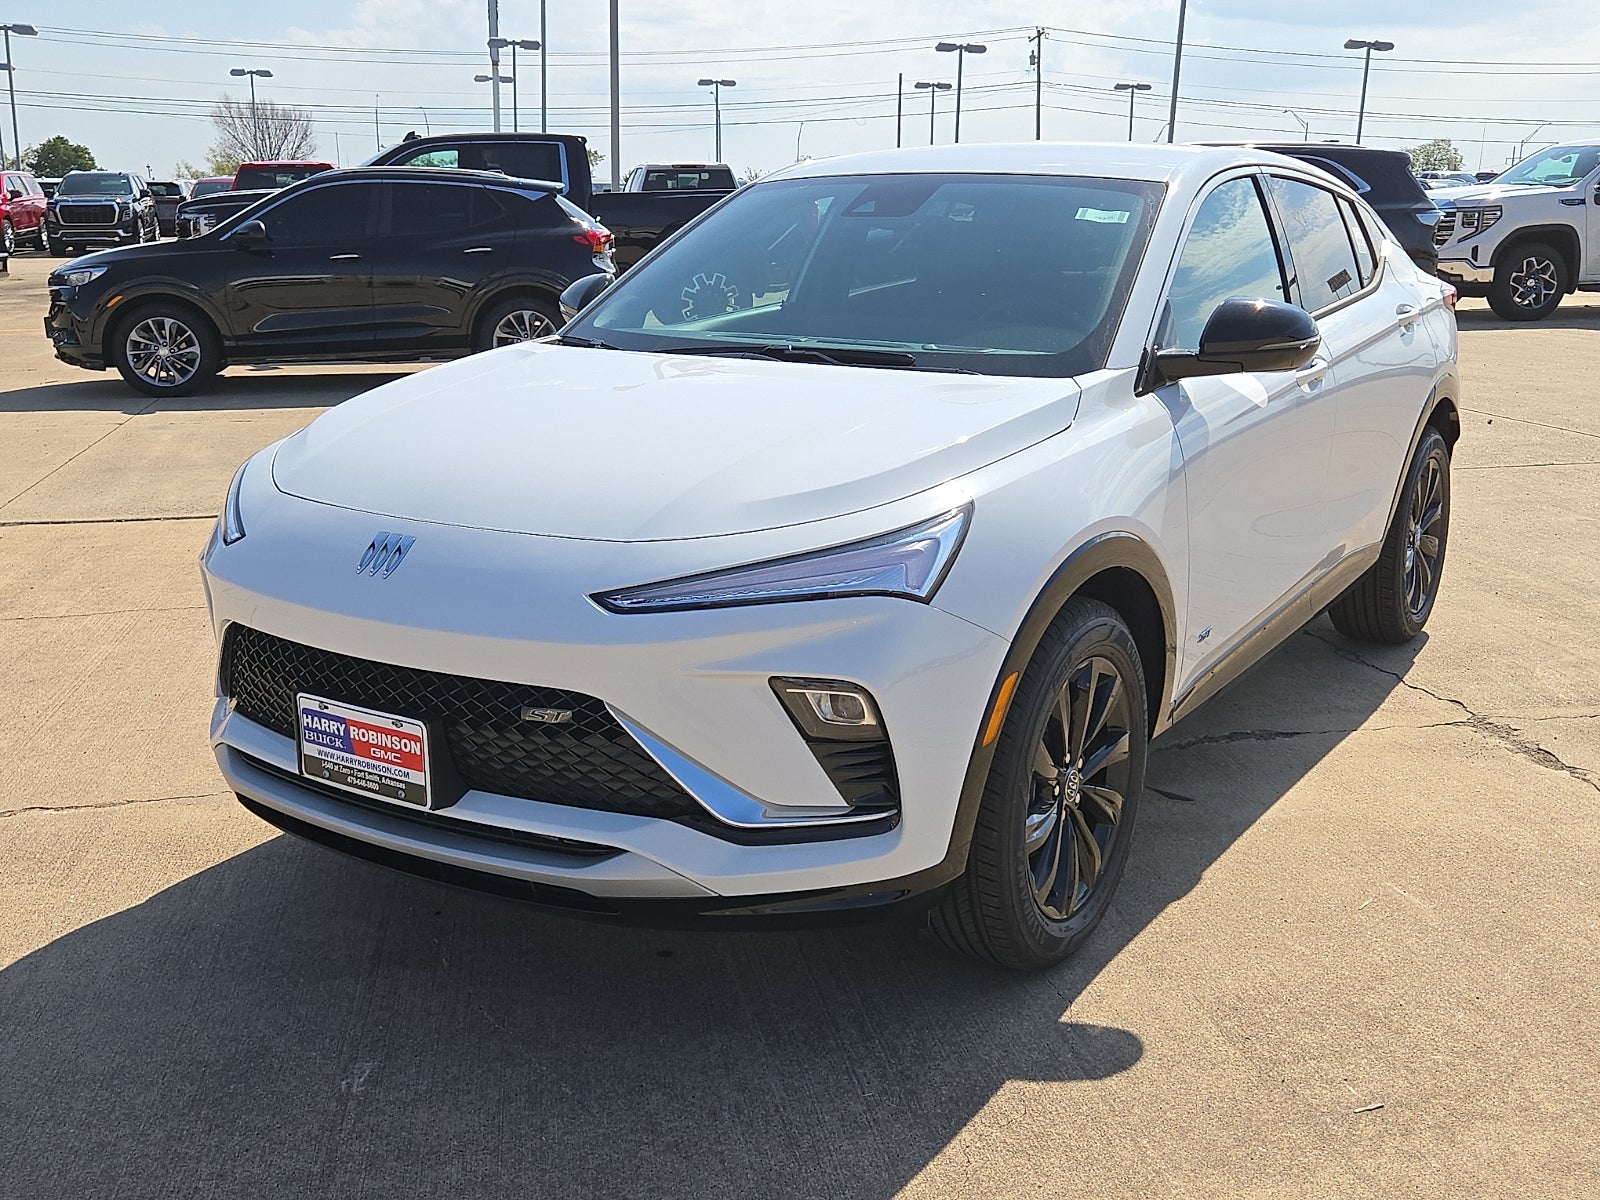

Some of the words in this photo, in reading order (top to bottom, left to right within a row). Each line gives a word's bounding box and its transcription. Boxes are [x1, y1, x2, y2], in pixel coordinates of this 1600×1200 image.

[524, 708, 570, 723] ST
[302, 713, 346, 737] HARRY
[349, 725, 421, 755] ROBINSON
[304, 730, 345, 748] BUICK
[316, 748, 410, 780] WWW.HARRYROBINSON.COM
[370, 747, 402, 763] GMC
[353, 769, 365, 779] Fort
[381, 776, 406, 789] Arkansas
